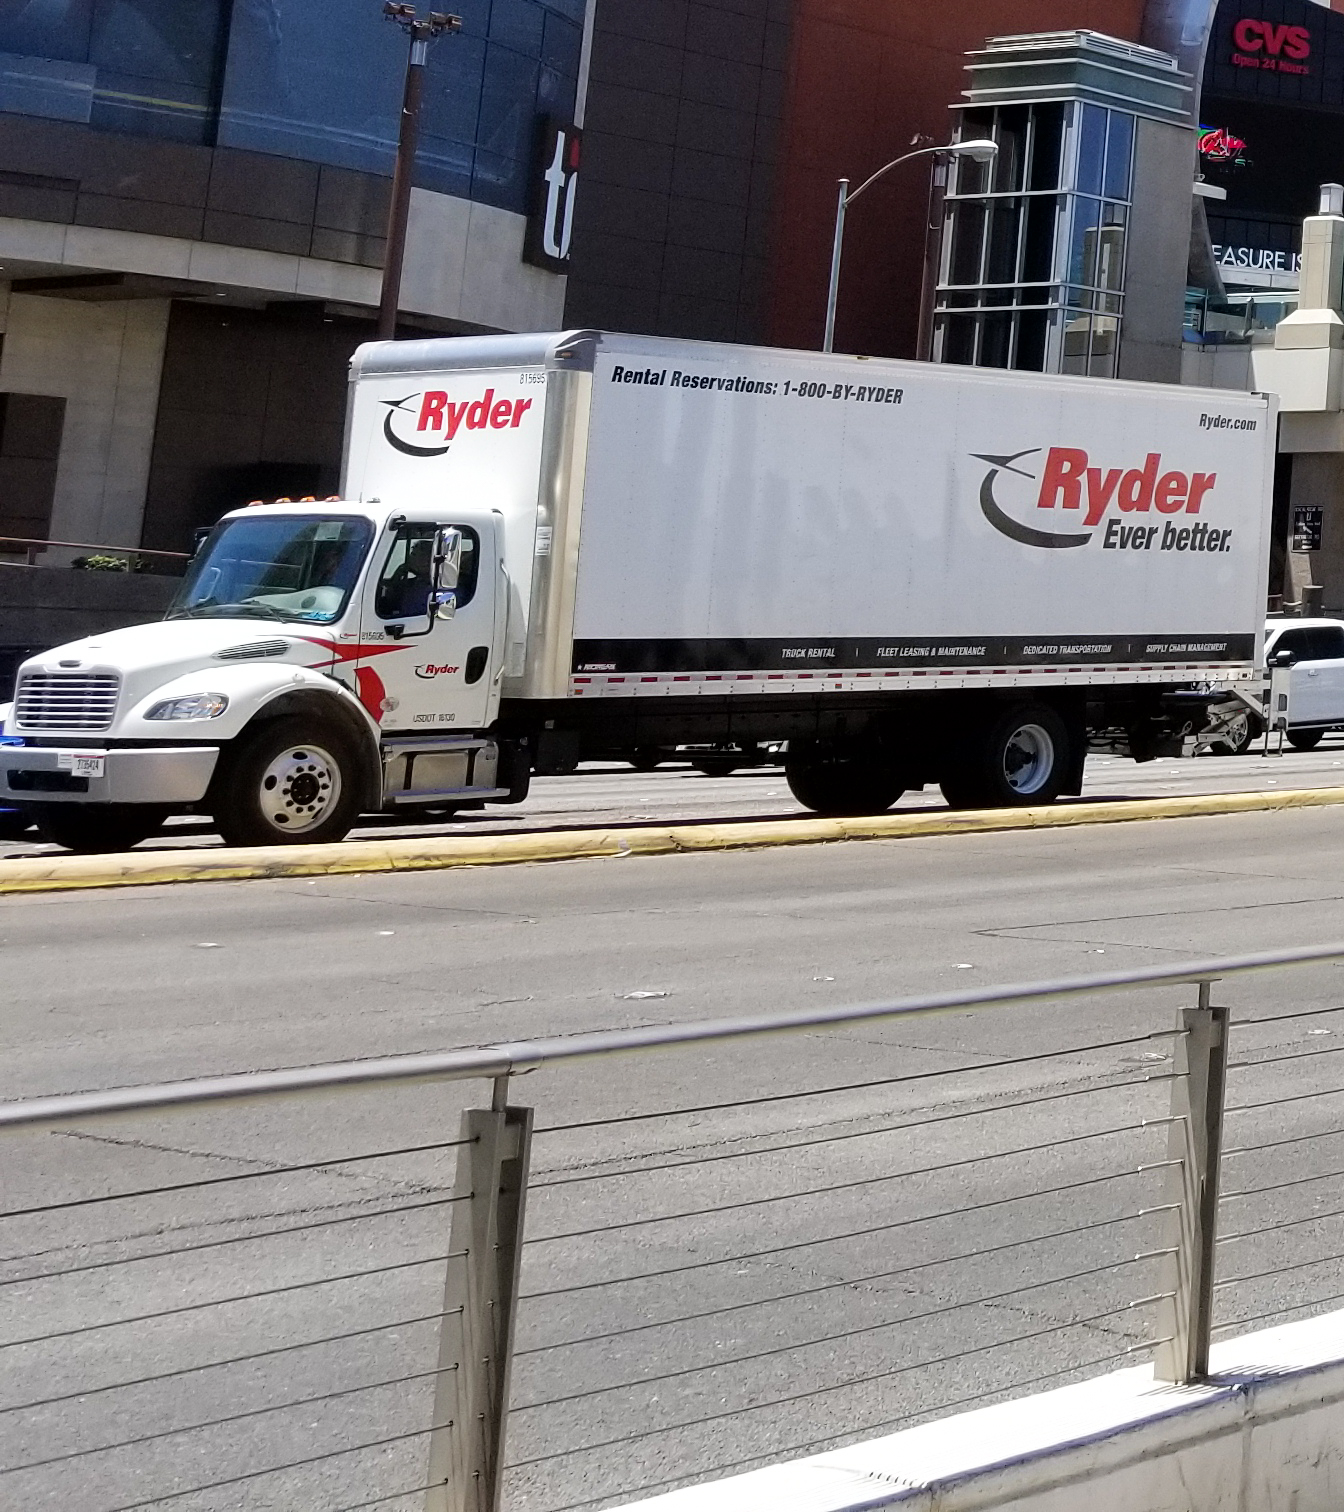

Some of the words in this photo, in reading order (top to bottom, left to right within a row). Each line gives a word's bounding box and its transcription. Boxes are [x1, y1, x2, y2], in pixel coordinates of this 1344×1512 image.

[1234, 18, 1311, 60] CVS
[1233, 53, 1260, 68] Open
[1262, 58, 1276, 70] 24
[1278, 60, 1310, 75] Hours
[611, 365, 667, 386] Rental
[669, 370, 778, 395] Reservations:
[783, 380, 904, 405] 1-800-BY-RYDER
[416, 388, 533, 441] Ryder
[1199, 413, 1257, 431] Ryder.com
[1037, 446, 1217, 526] Ryder
[1103, 518, 1159, 550] Ever
[1160, 520, 1232, 552] better.
[781, 648, 806, 658] TRUCK
[807, 648, 836, 657] RENTAL
[876, 647, 899, 657] FLEET
[900, 647, 929, 657] LEASING
[937, 646, 987, 656] MAINTENANCE
[1023, 645, 1057, 654] DEDICATED
[1059, 644, 1112, 654] TRANSPORTATION
[1146, 644, 1168, 652] SUPPLY
[1169, 643, 1187, 652] CHAIN
[1187, 643, 1228, 651] MANAGEMENT
[425, 663, 460, 675] Ryder
